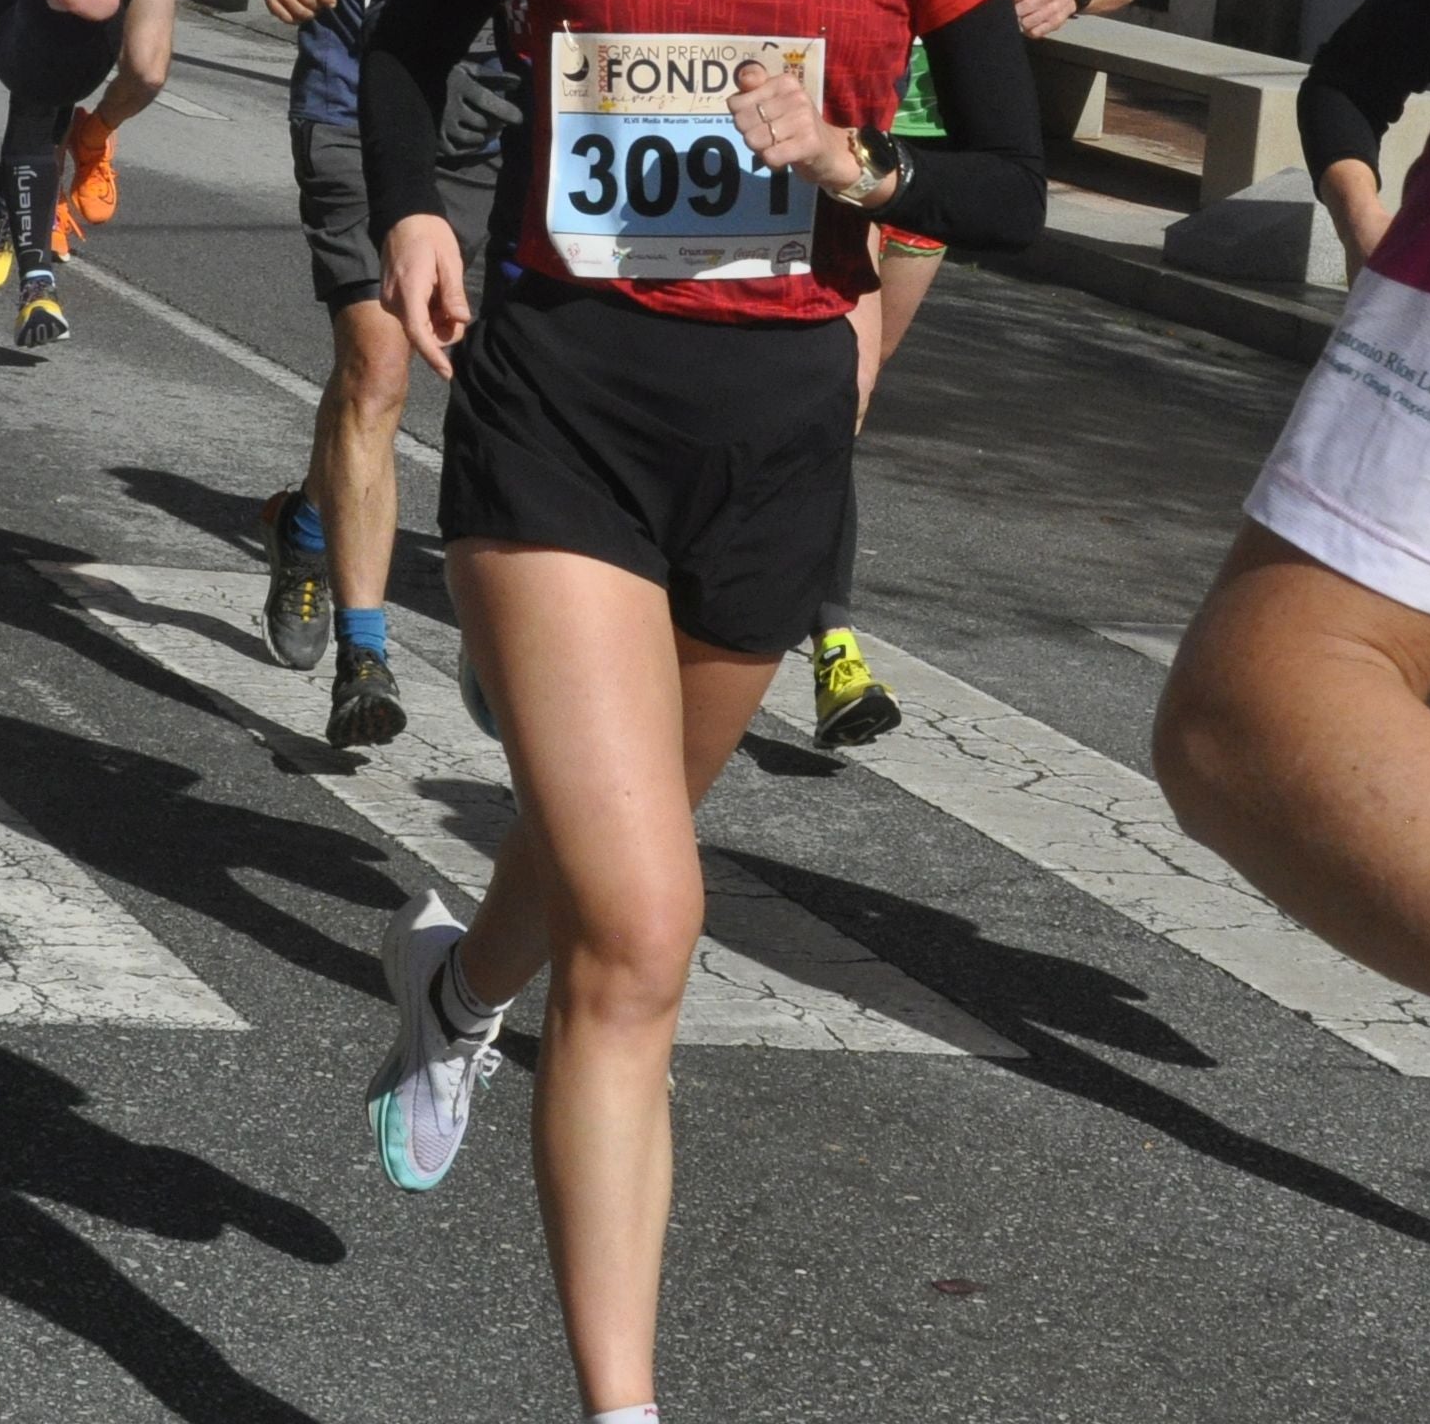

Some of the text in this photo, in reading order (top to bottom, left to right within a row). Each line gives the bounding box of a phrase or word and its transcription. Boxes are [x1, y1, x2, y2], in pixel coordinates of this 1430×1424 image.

[607, 45, 660, 61] GRAN
[667, 46, 737, 61] PREMIO
[568, 133, 790, 218] 3091
